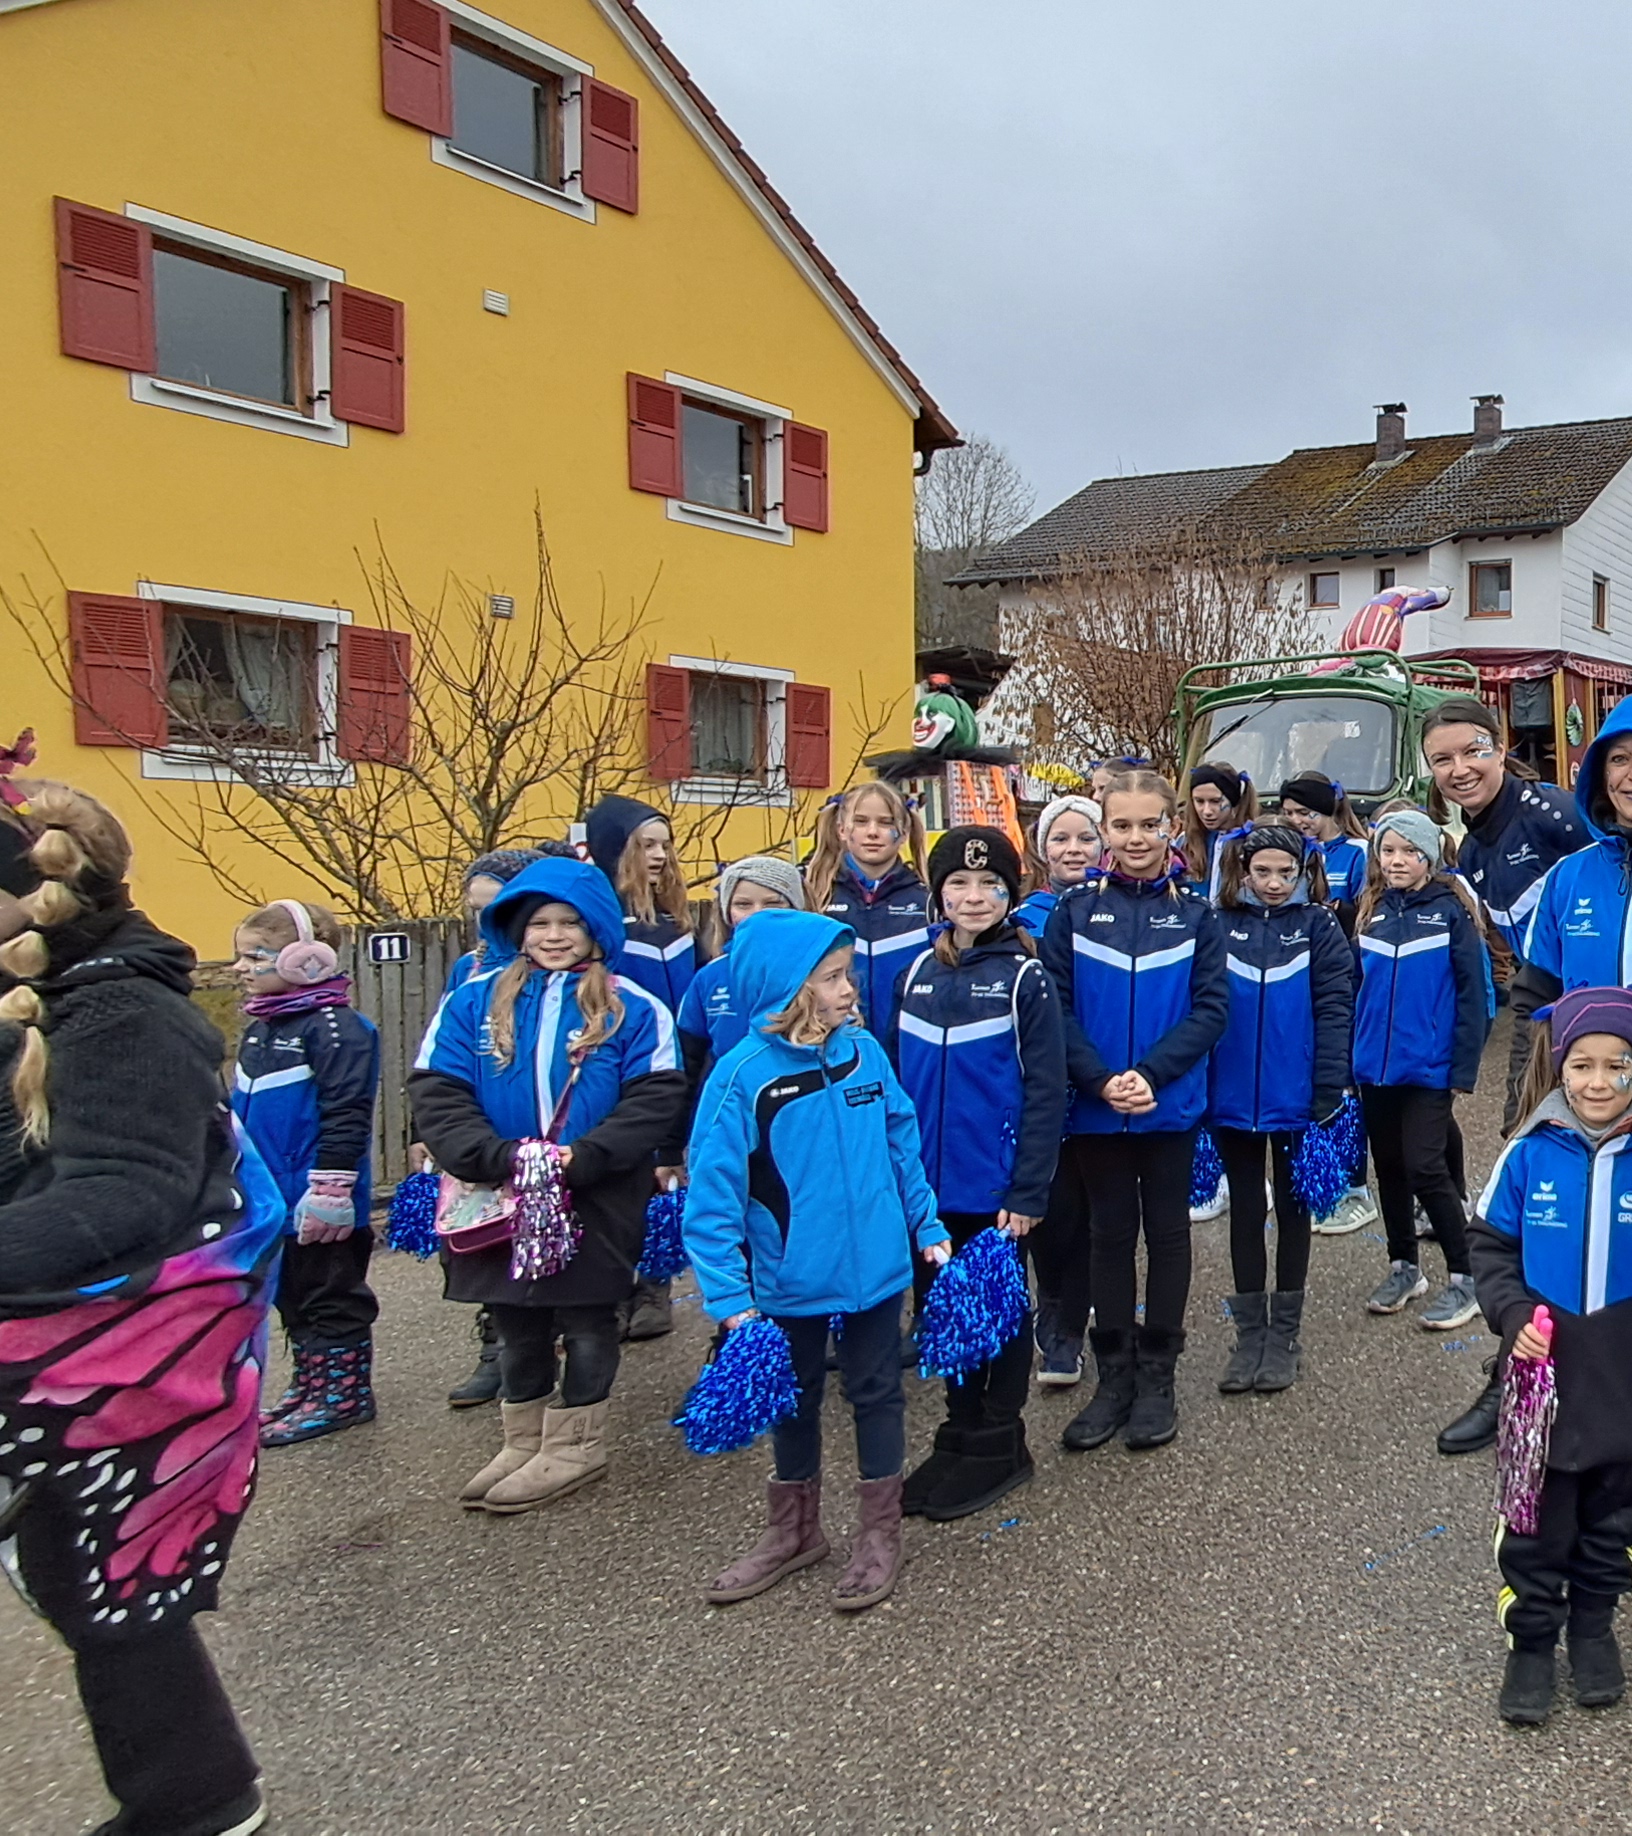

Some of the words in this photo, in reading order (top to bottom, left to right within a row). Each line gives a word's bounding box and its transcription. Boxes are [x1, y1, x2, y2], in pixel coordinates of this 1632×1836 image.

[965, 839, 988, 869] C
[1090, 913, 1115, 923] JAKO
[378, 937, 402, 960] 11
